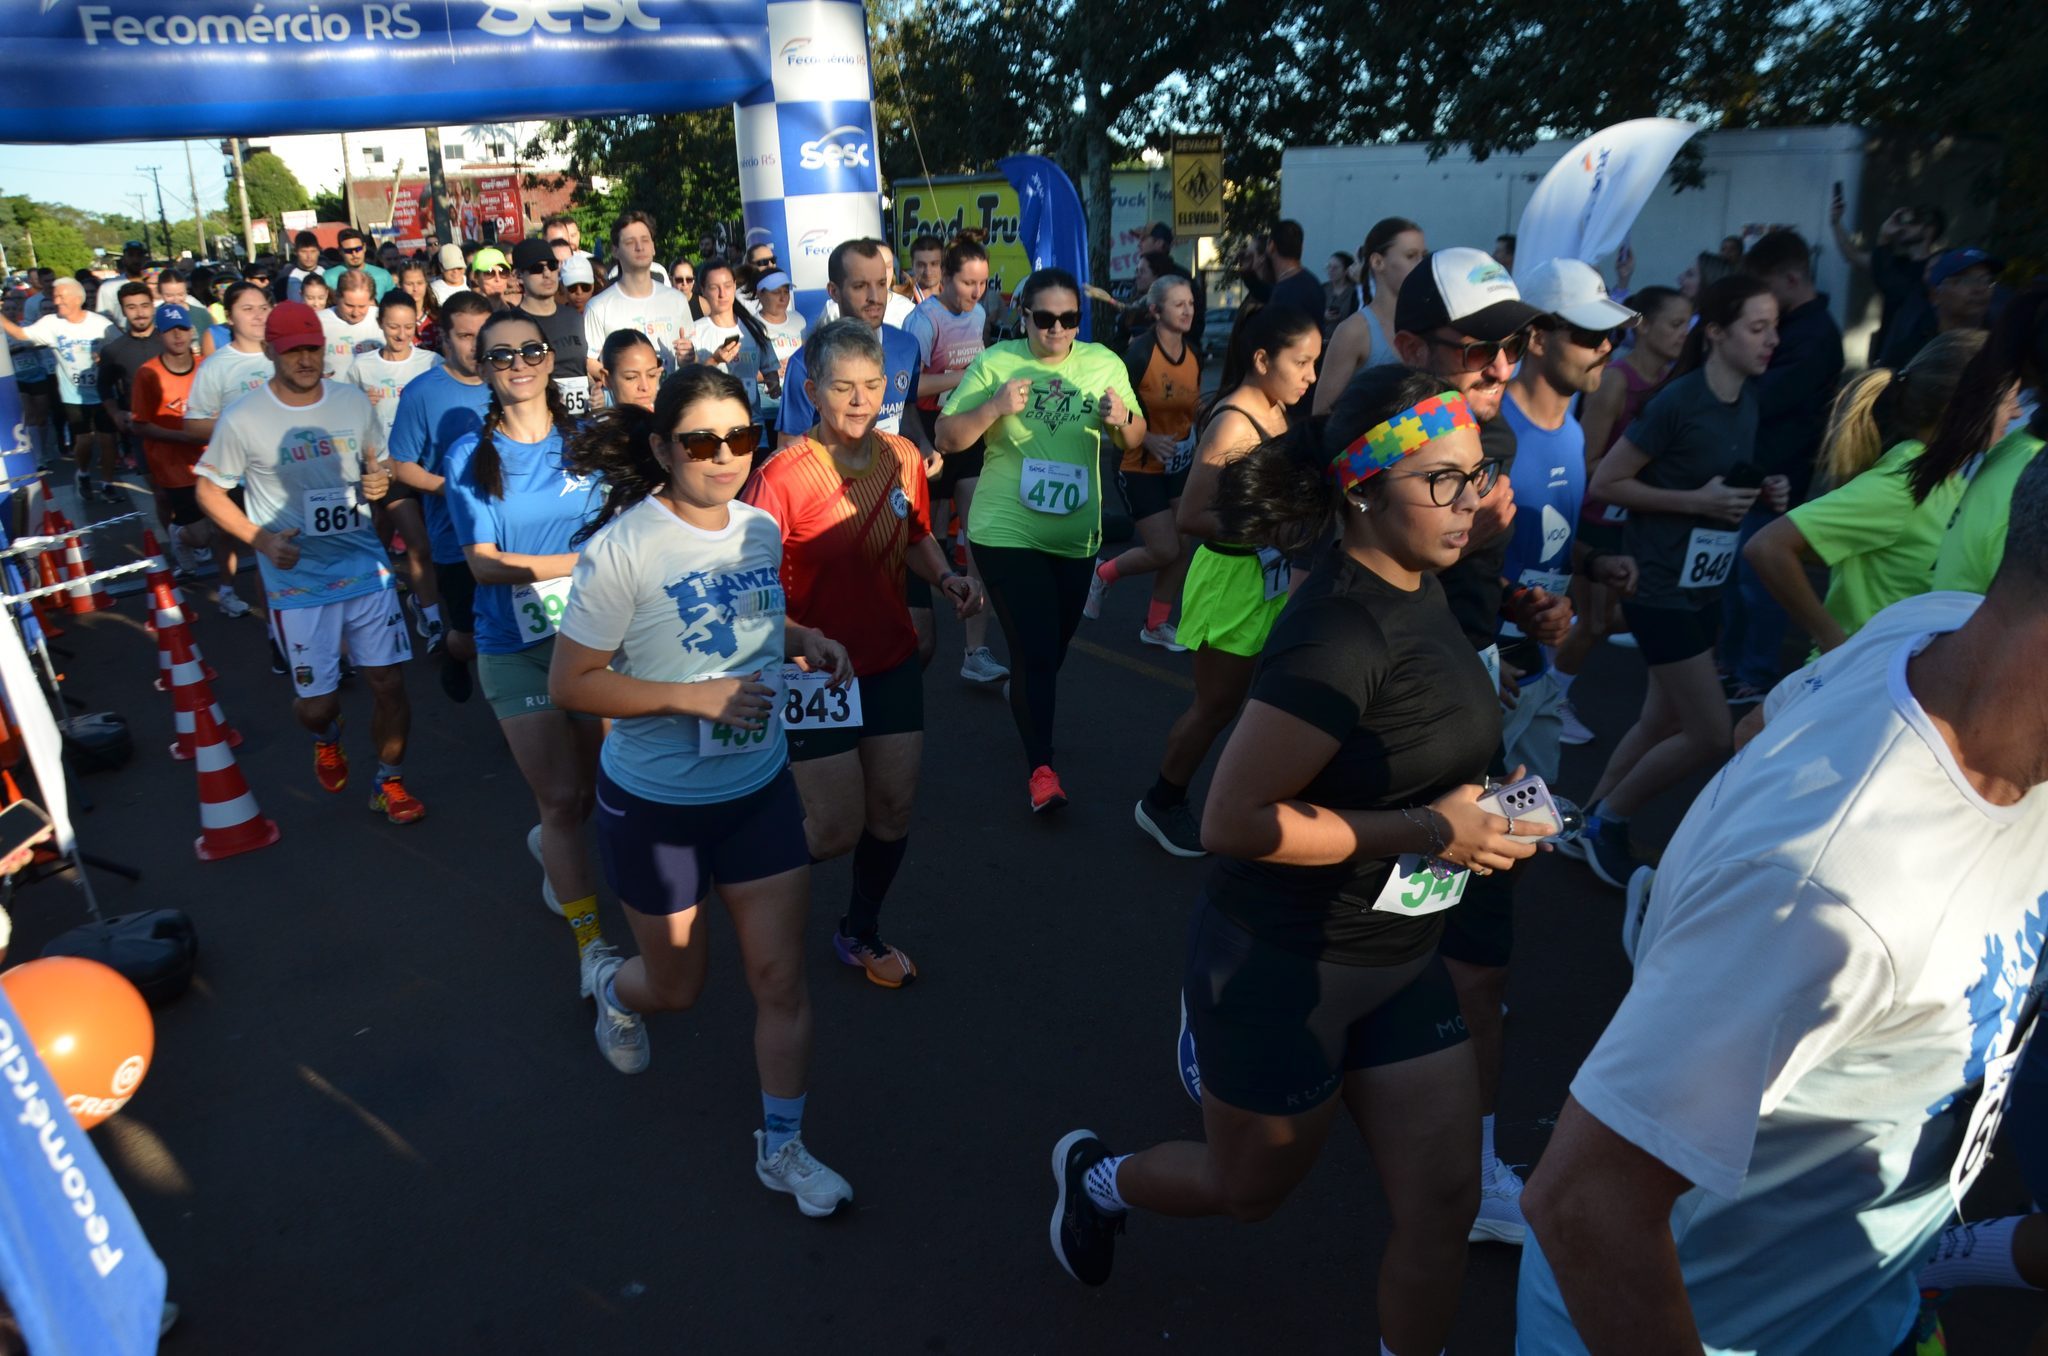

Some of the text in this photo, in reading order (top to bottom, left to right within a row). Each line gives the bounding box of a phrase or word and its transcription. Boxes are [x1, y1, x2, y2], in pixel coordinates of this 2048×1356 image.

[78, 3, 422, 46] Fecomércio RS
[800, 141, 869, 170] Sesc
[1175, 139, 1219, 149] DEVAGAR
[903, 194, 1020, 247] Food Tru
[1178, 211, 1219, 225] ELEVADA
[1025, 410, 1081, 422] CORREM
[281, 437, 358, 466] Autismo
[1027, 478, 1080, 511] 470
[314, 503, 360, 532] 861
[1690, 551, 1732, 583] 848
[522, 594, 567, 634] 39
[784, 687, 850, 724] 843
[65, 1093, 133, 1115] CRES
